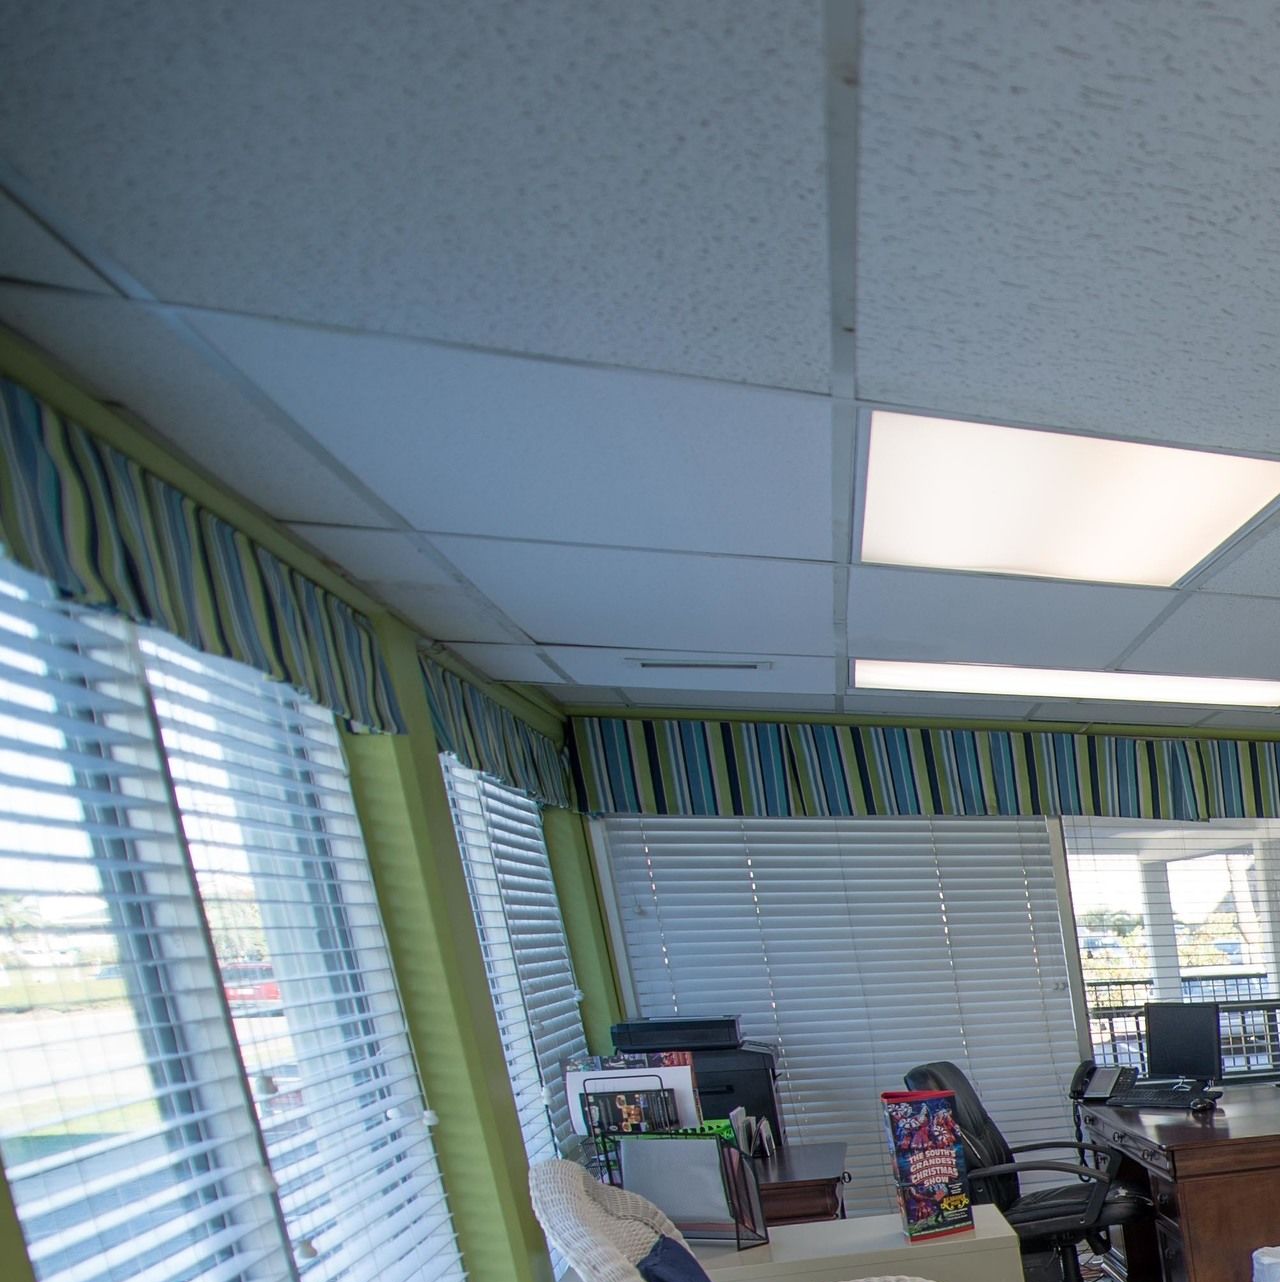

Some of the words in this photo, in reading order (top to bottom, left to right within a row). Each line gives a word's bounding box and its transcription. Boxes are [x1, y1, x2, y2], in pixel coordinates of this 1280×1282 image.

[909, 1153, 924, 1165] THE
[910, 1159, 957, 1172] GRANDEST
[911, 1167, 959, 1184] CHRISTMAS
[924, 1176, 949, 1187] SHOW
